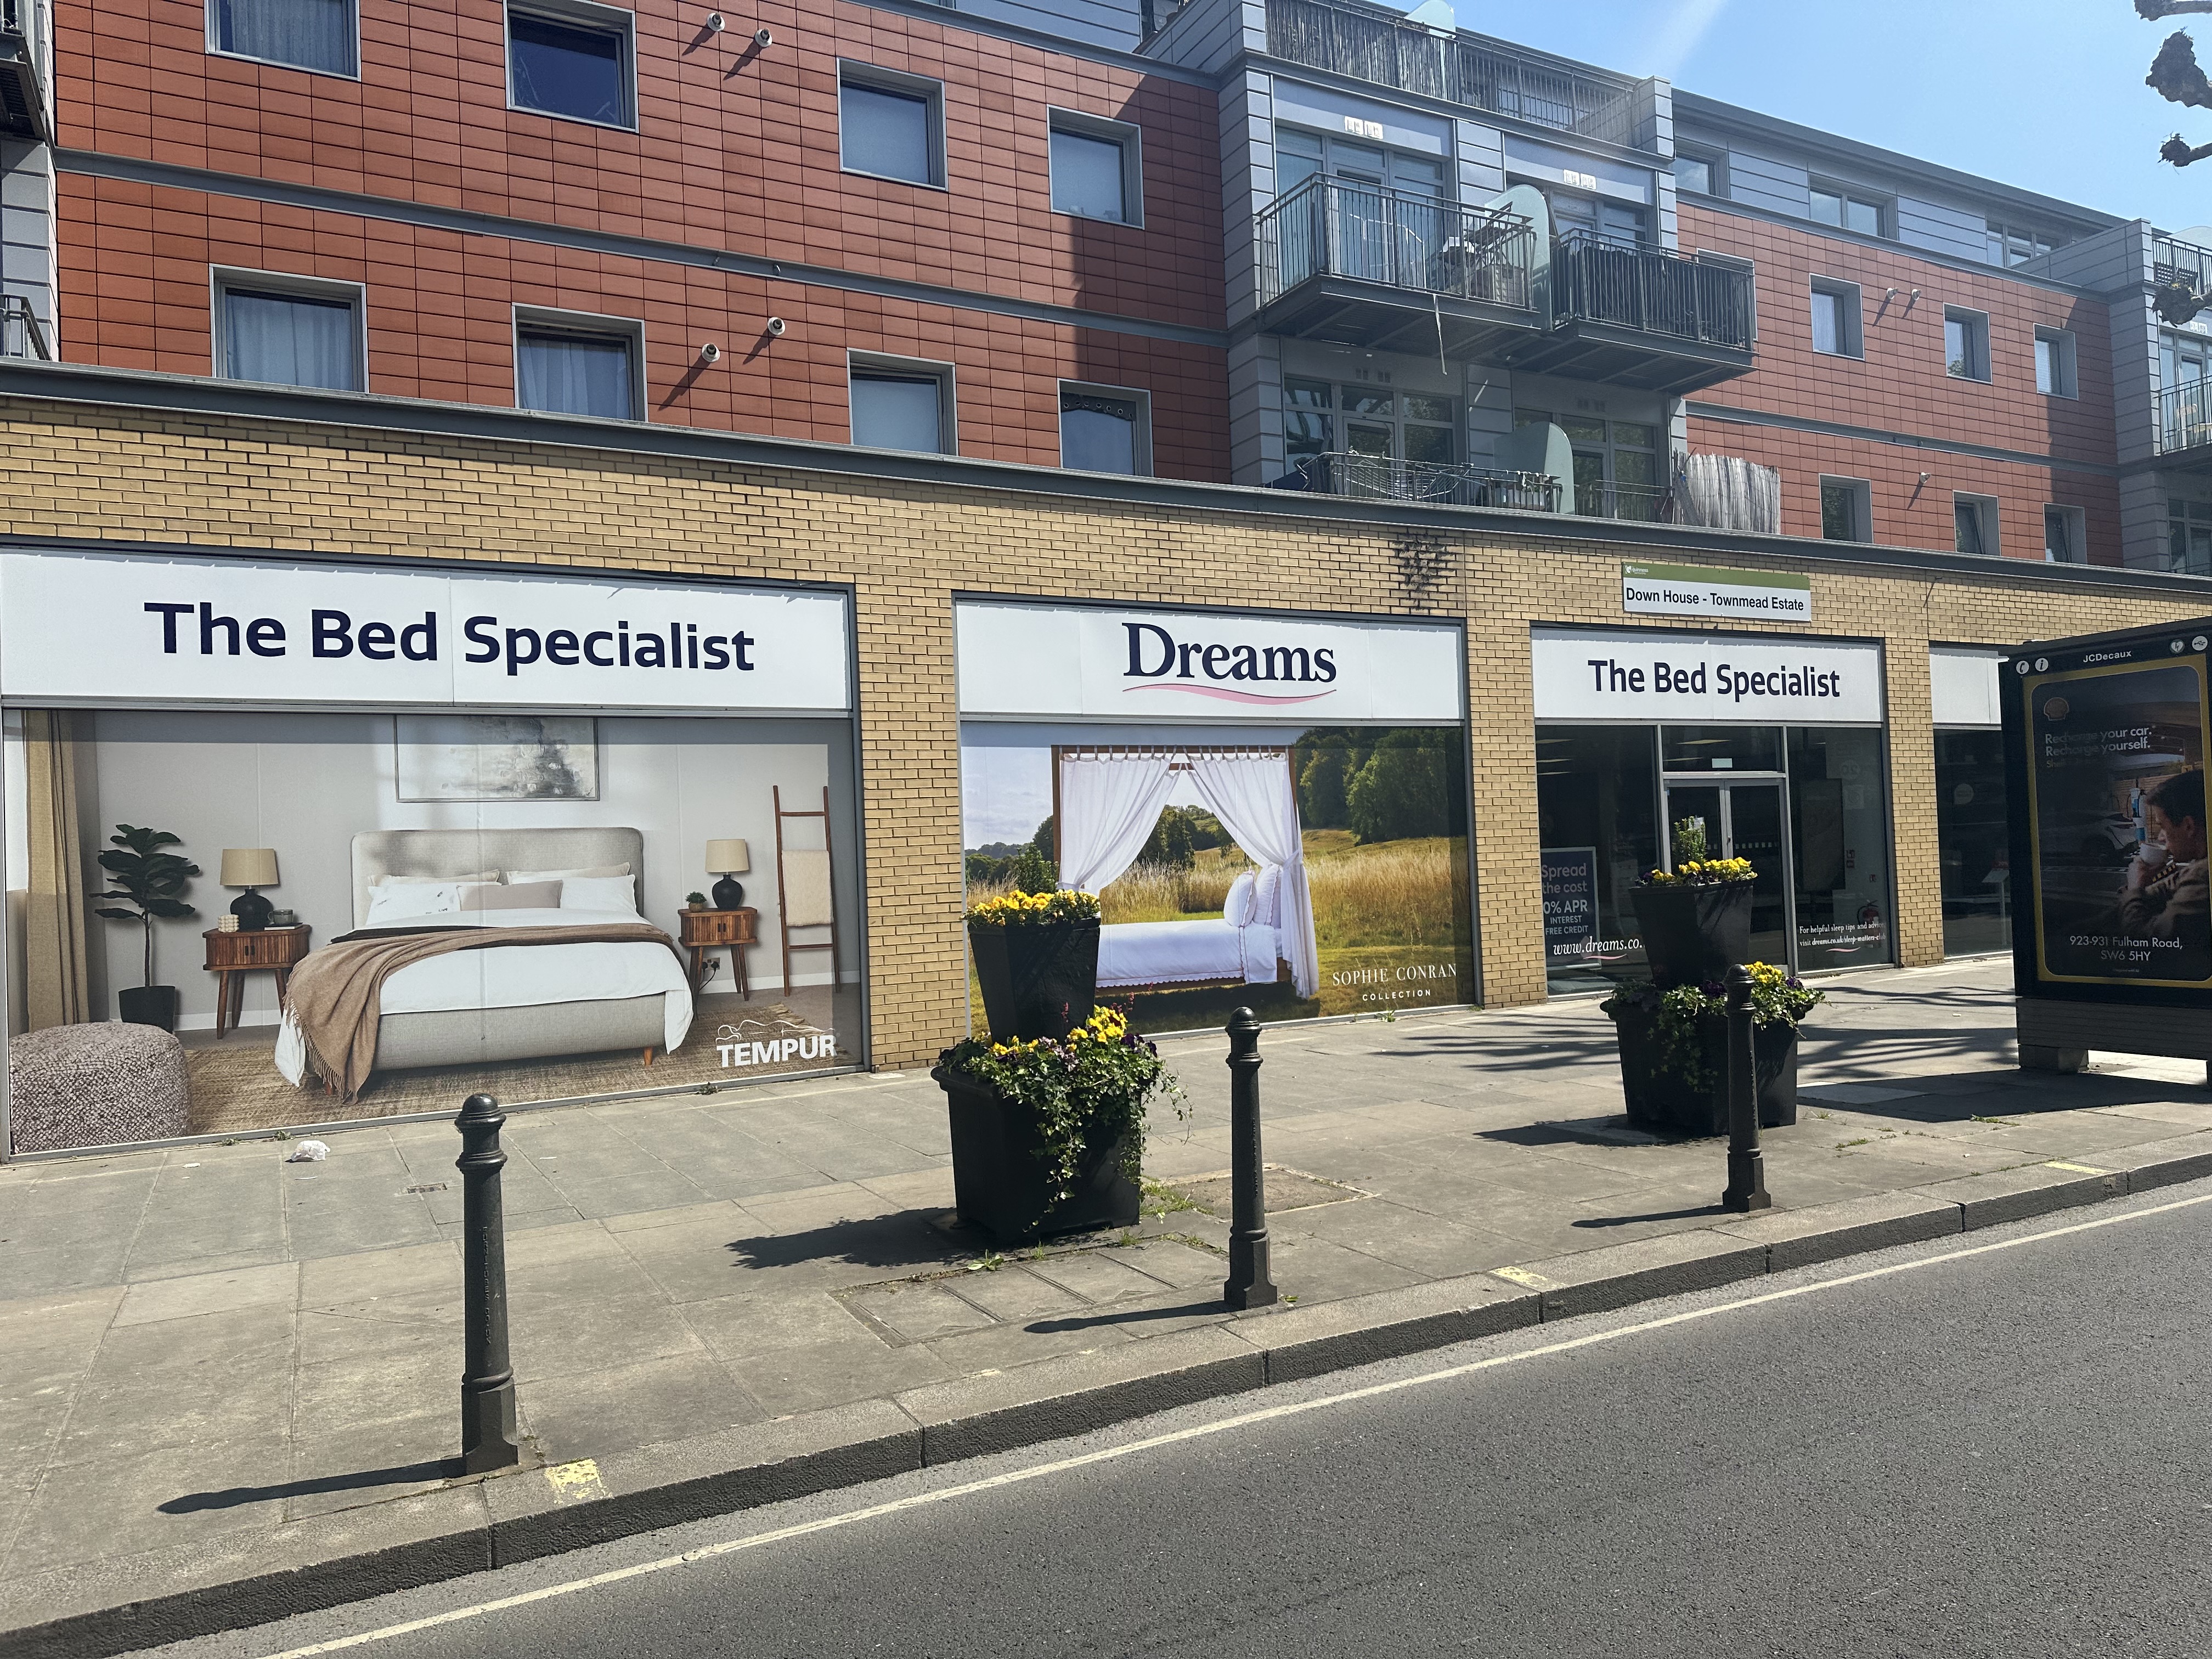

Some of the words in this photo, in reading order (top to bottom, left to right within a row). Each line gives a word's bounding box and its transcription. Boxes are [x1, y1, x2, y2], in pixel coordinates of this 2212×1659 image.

[1626, 588, 1660, 602] Down
[1663, 590, 1699, 604] House
[1710, 592, 1768, 608] Townmead
[1771, 597, 1804, 611] Estate
[144, 602, 286, 657] The
[311, 609, 437, 661] Bed
[464, 616, 755, 676] Specialist
[1121, 622, 1337, 682] Dreams
[2083, 650, 2132, 663] JCDecaux
[1588, 659, 1645, 692] The
[1654, 662, 1707, 694] Bed
[1717, 664, 1841, 703] Specialist
[2100, 729, 2128, 742] your
[2130, 727, 2152, 736] car.
[2046, 743, 2098, 756] Recharge
[2101, 736, 2151, 754] yourself.
[1541, 862, 1587, 881] Spread
[1542, 882, 1560, 894] the
[1564, 880, 1588, 893] cost
[1543, 901, 1561, 914] 0%
[1564, 900, 1588, 913] APR
[1550, 915, 1582, 924] INTEREST
[1545, 927, 1562, 935] FREE
[1564, 925, 1588, 934] CREDIT
[1810, 924, 1830, 935] helpful
[1831, 924, 1844, 933] sleep
[1846, 924, 1855, 932] tips
[1553, 936, 1645, 955] www.dreams.co.
[2069, 935, 2108, 946] 923-931
[2113, 936, 2148, 947] Fulham
[2152, 937, 2183, 949] Road,
[2101, 950, 2125, 960] SW6
[2129, 951, 2151, 961] 5HY
[1333, 968, 1389, 986] SOPHIE
[1396, 963, 1457, 981] CONRAN
[1362, 989, 1431, 1001] COLLECTION
[716, 1035, 837, 1068] TEMPUR
